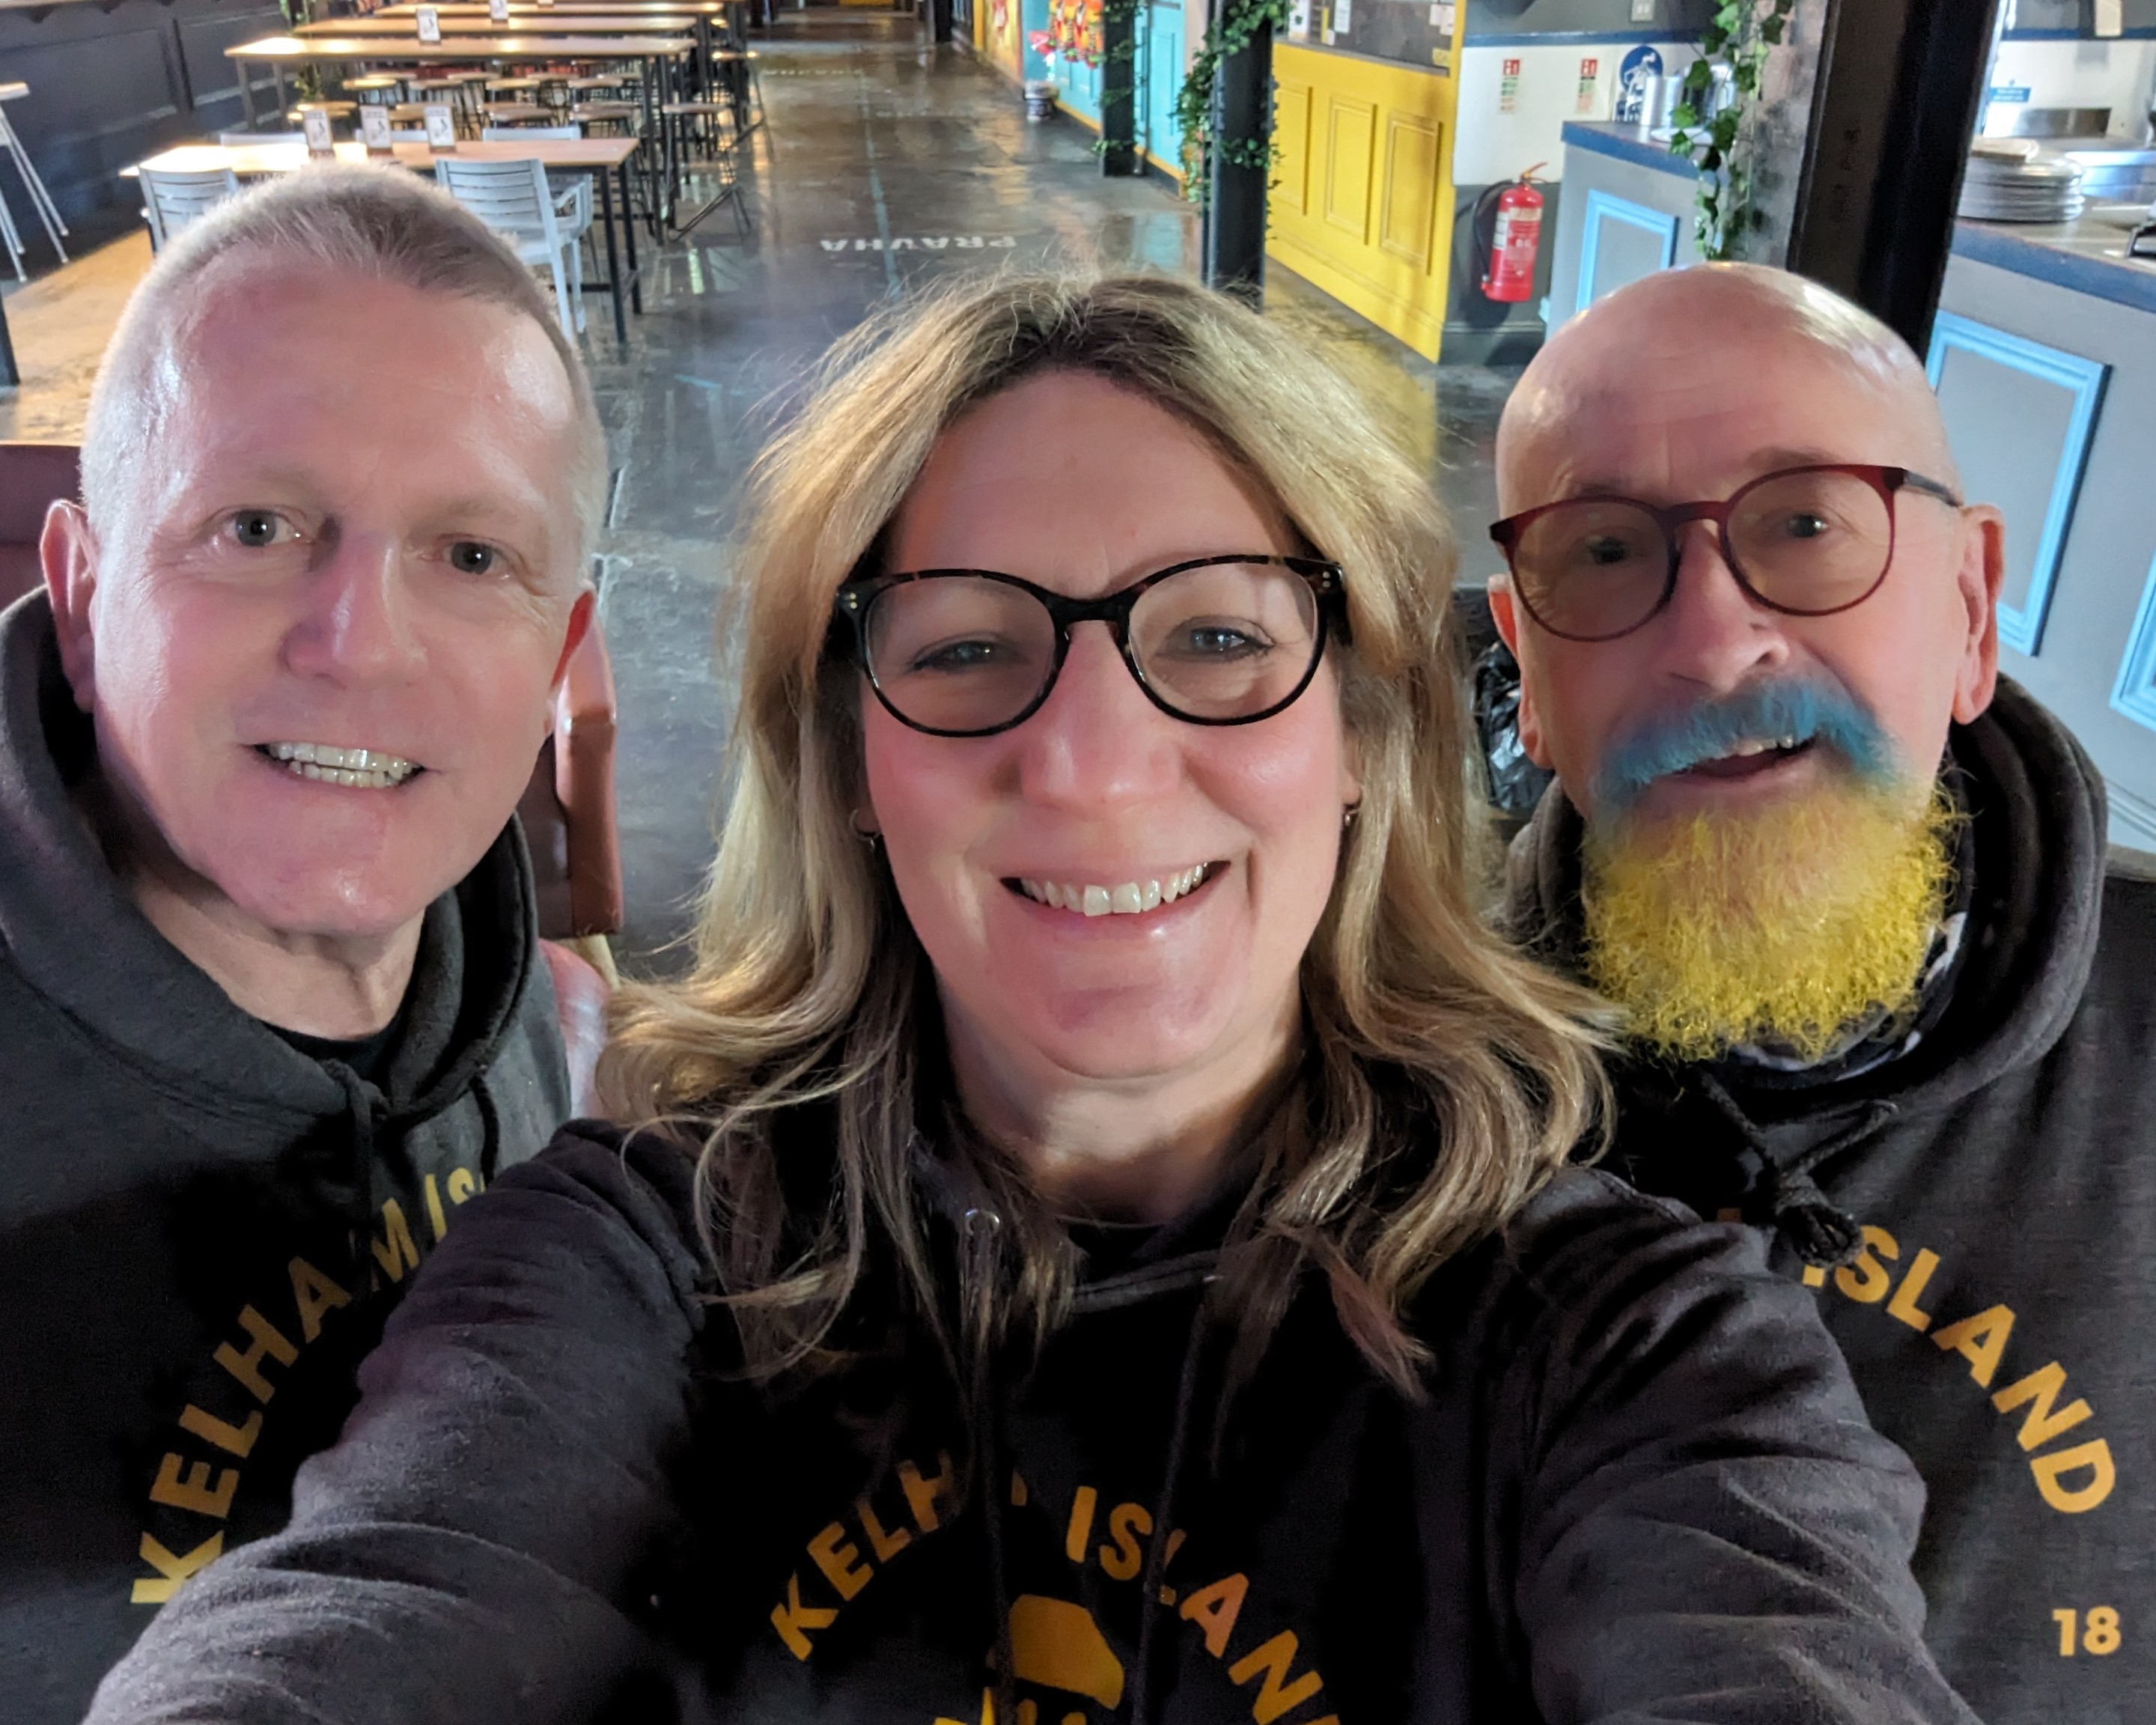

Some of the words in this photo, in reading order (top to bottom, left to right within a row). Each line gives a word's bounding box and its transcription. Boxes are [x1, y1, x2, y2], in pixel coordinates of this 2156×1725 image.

[820, 236, 1017, 252] PRAVHA
[130, 1197, 420, 1604] KELHAM
[1802, 1224, 2116, 1514] SLAND
[770, 1449, 1028, 1662] KELH
[1065, 1485, 1342, 1725] ISAN
[2052, 1605, 2122, 1658] 18
